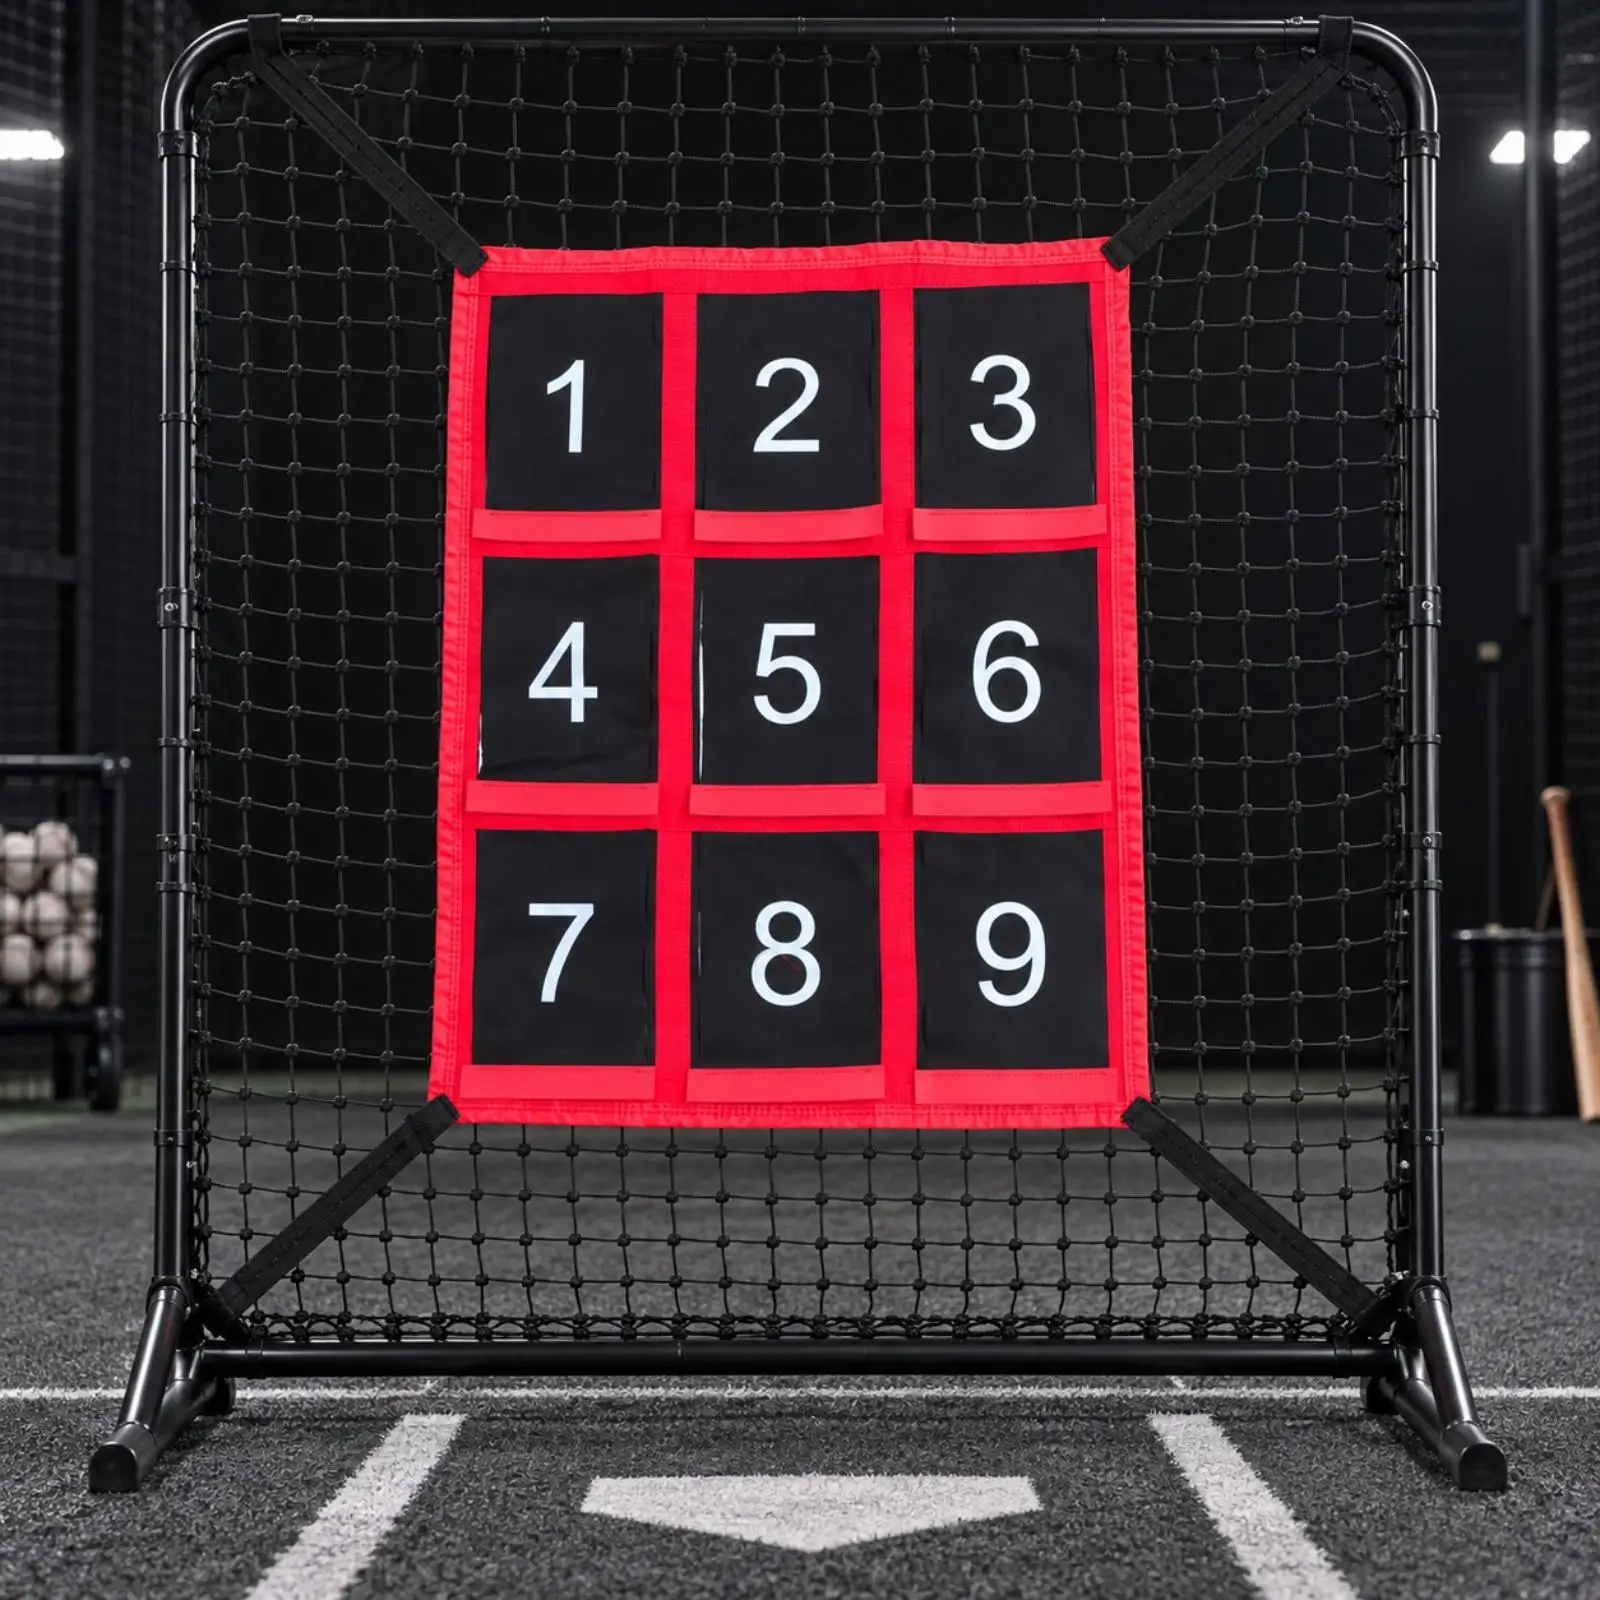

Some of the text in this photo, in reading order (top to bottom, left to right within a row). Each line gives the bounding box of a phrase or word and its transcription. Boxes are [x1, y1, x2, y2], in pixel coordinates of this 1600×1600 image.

[546, 354, 1037, 454] 1 2 3
[528, 619, 1042, 725] 4 5 6
[528, 900, 1046, 1007] 7 8 9
